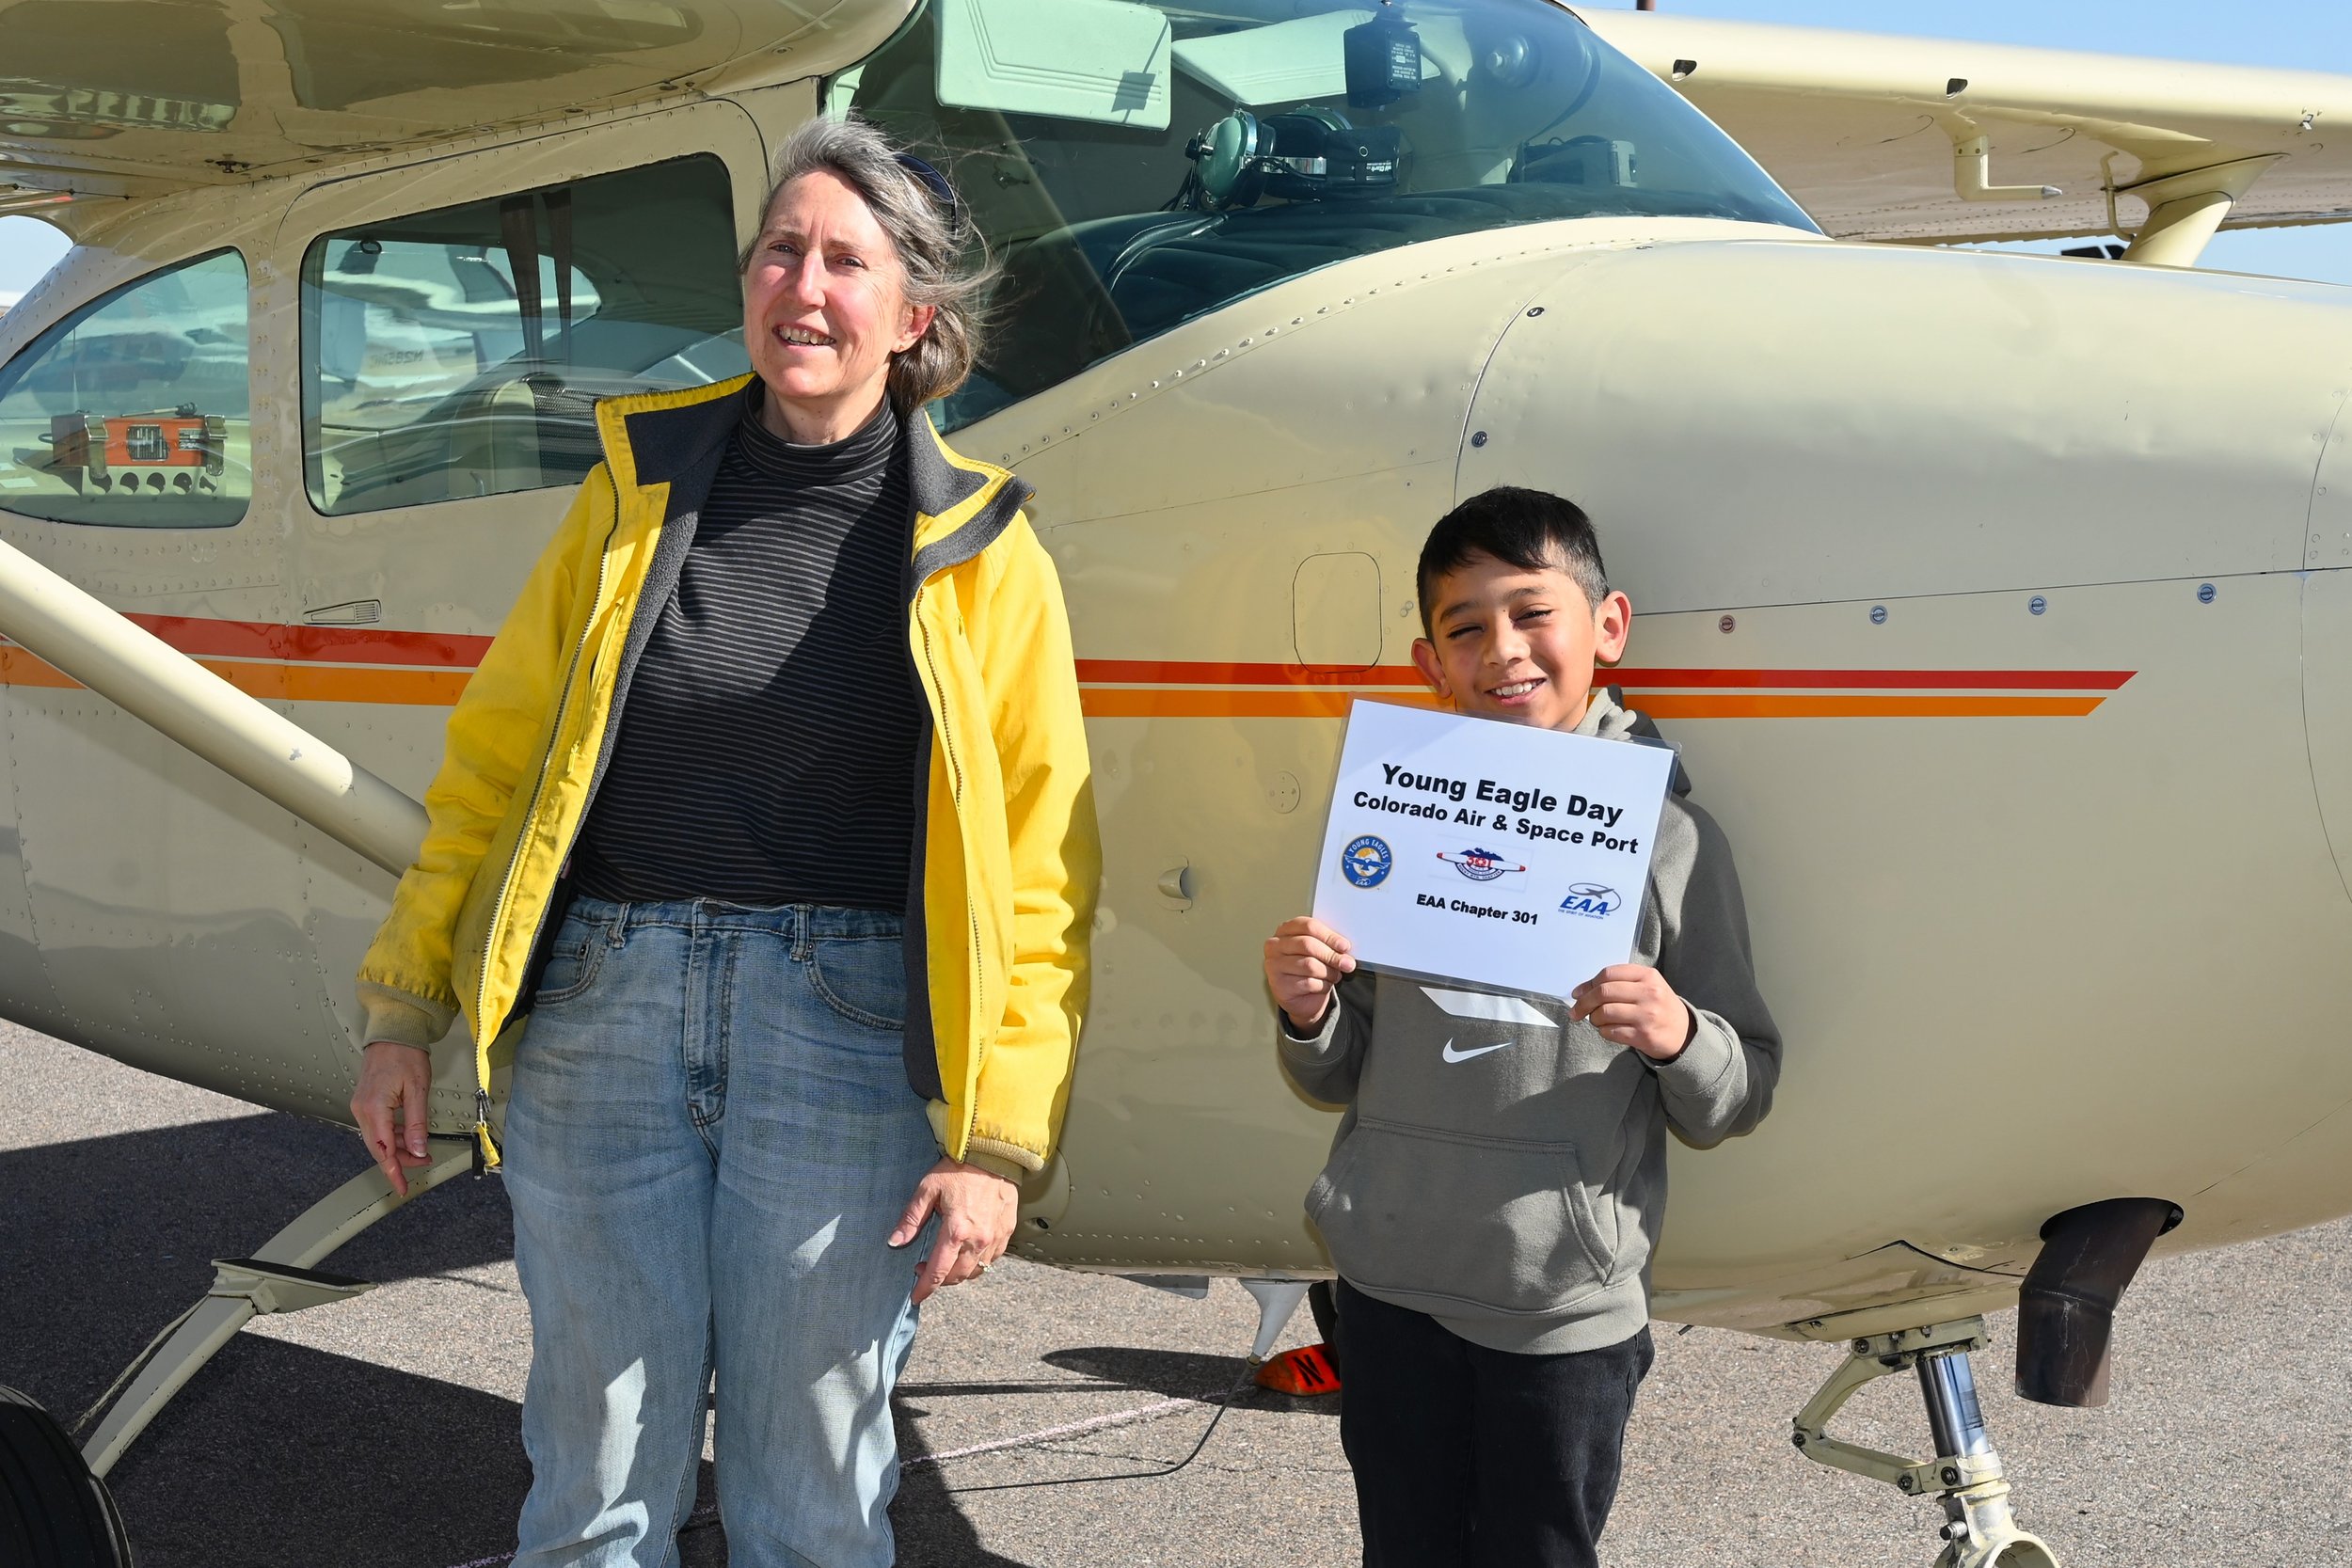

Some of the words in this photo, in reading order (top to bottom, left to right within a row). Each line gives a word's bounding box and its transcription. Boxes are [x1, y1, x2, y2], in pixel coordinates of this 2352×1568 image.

[1382, 763, 1467, 802] Young
[1475, 779, 1557, 813] Eagle
[1566, 794, 1624, 828] Day
[1353, 791, 1448, 821] Colorado
[1453, 808, 1486, 827] Air
[1492, 814, 1508, 832] &
[1516, 817, 1584, 844] Space
[1591, 831, 1639, 854] Port
[1348, 838, 1370, 853] YOUNG
[1371, 839, 1389, 859] EAGLES
[1416, 893, 1446, 910] EAA
[1450, 899, 1509, 920] Chapter
[1511, 910, 1538, 926] 301
[1560, 895, 1609, 915] EAA
